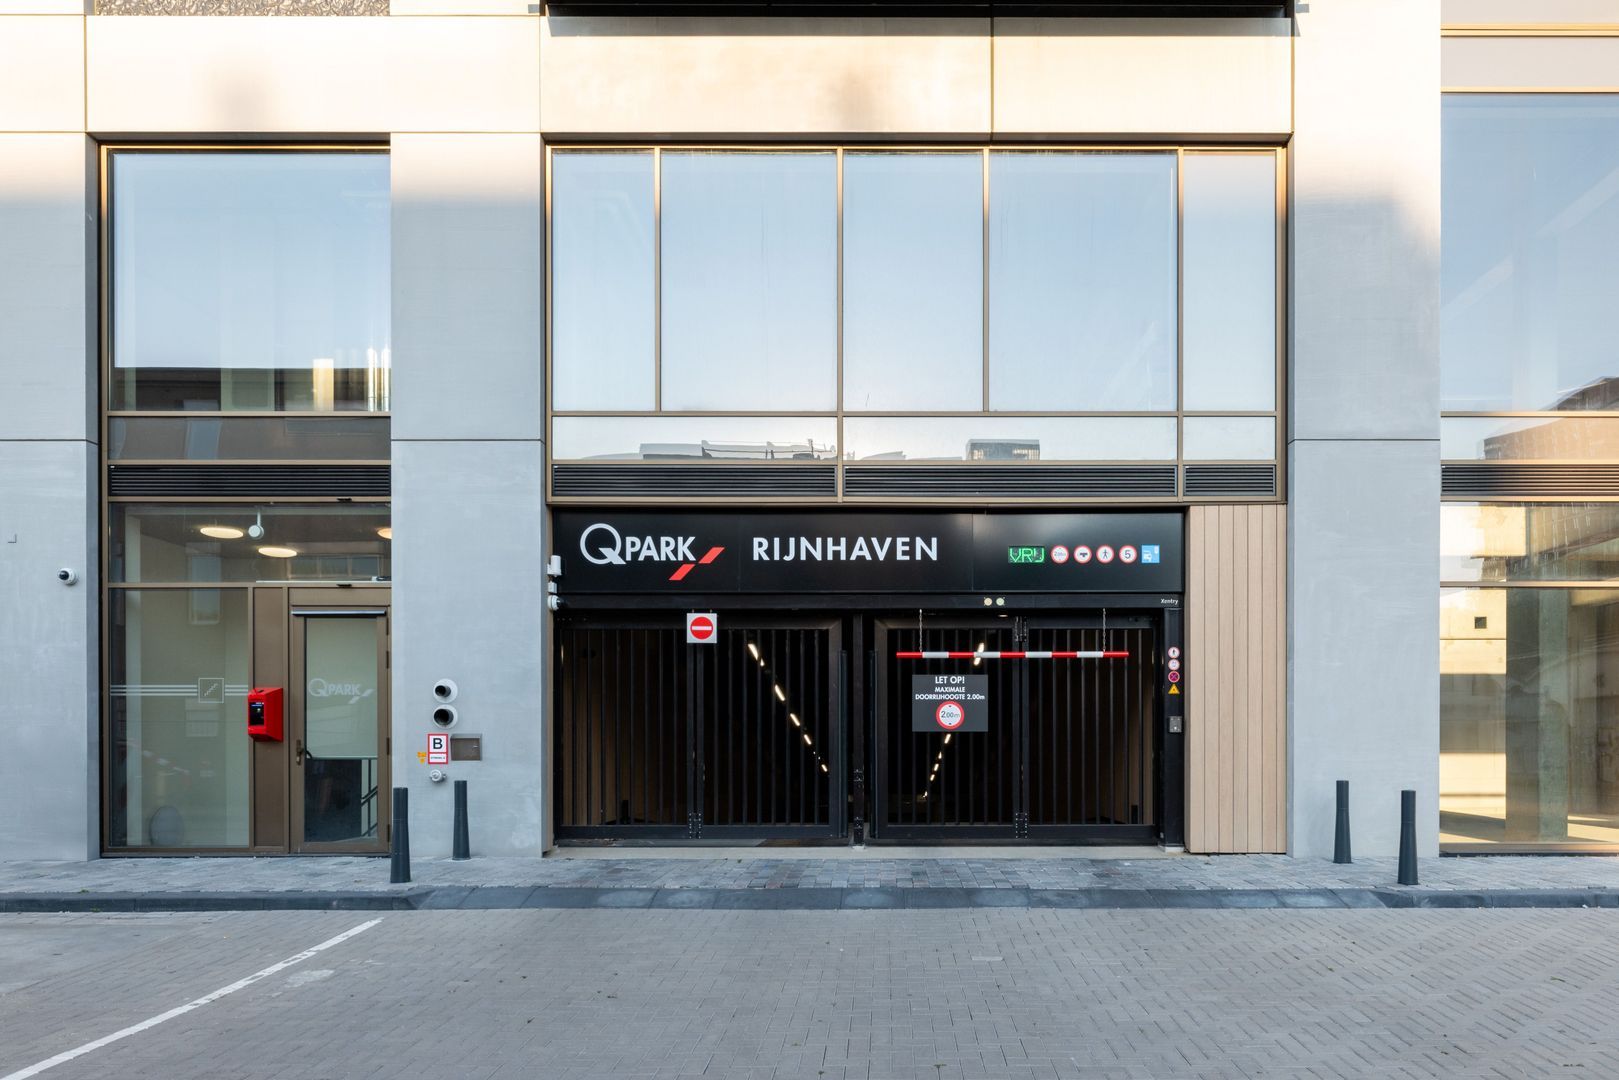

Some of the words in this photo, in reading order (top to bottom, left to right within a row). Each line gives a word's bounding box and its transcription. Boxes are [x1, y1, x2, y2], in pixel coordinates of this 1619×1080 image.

[753, 536, 938, 561] RIJNHAVEN
[1124, 549, 1132, 559] 5
[1009, 547, 1045, 563] VRIJ
[935, 676, 948, 684] LET
[950, 676, 965, 684] OP!
[433, 738, 443, 749] B
